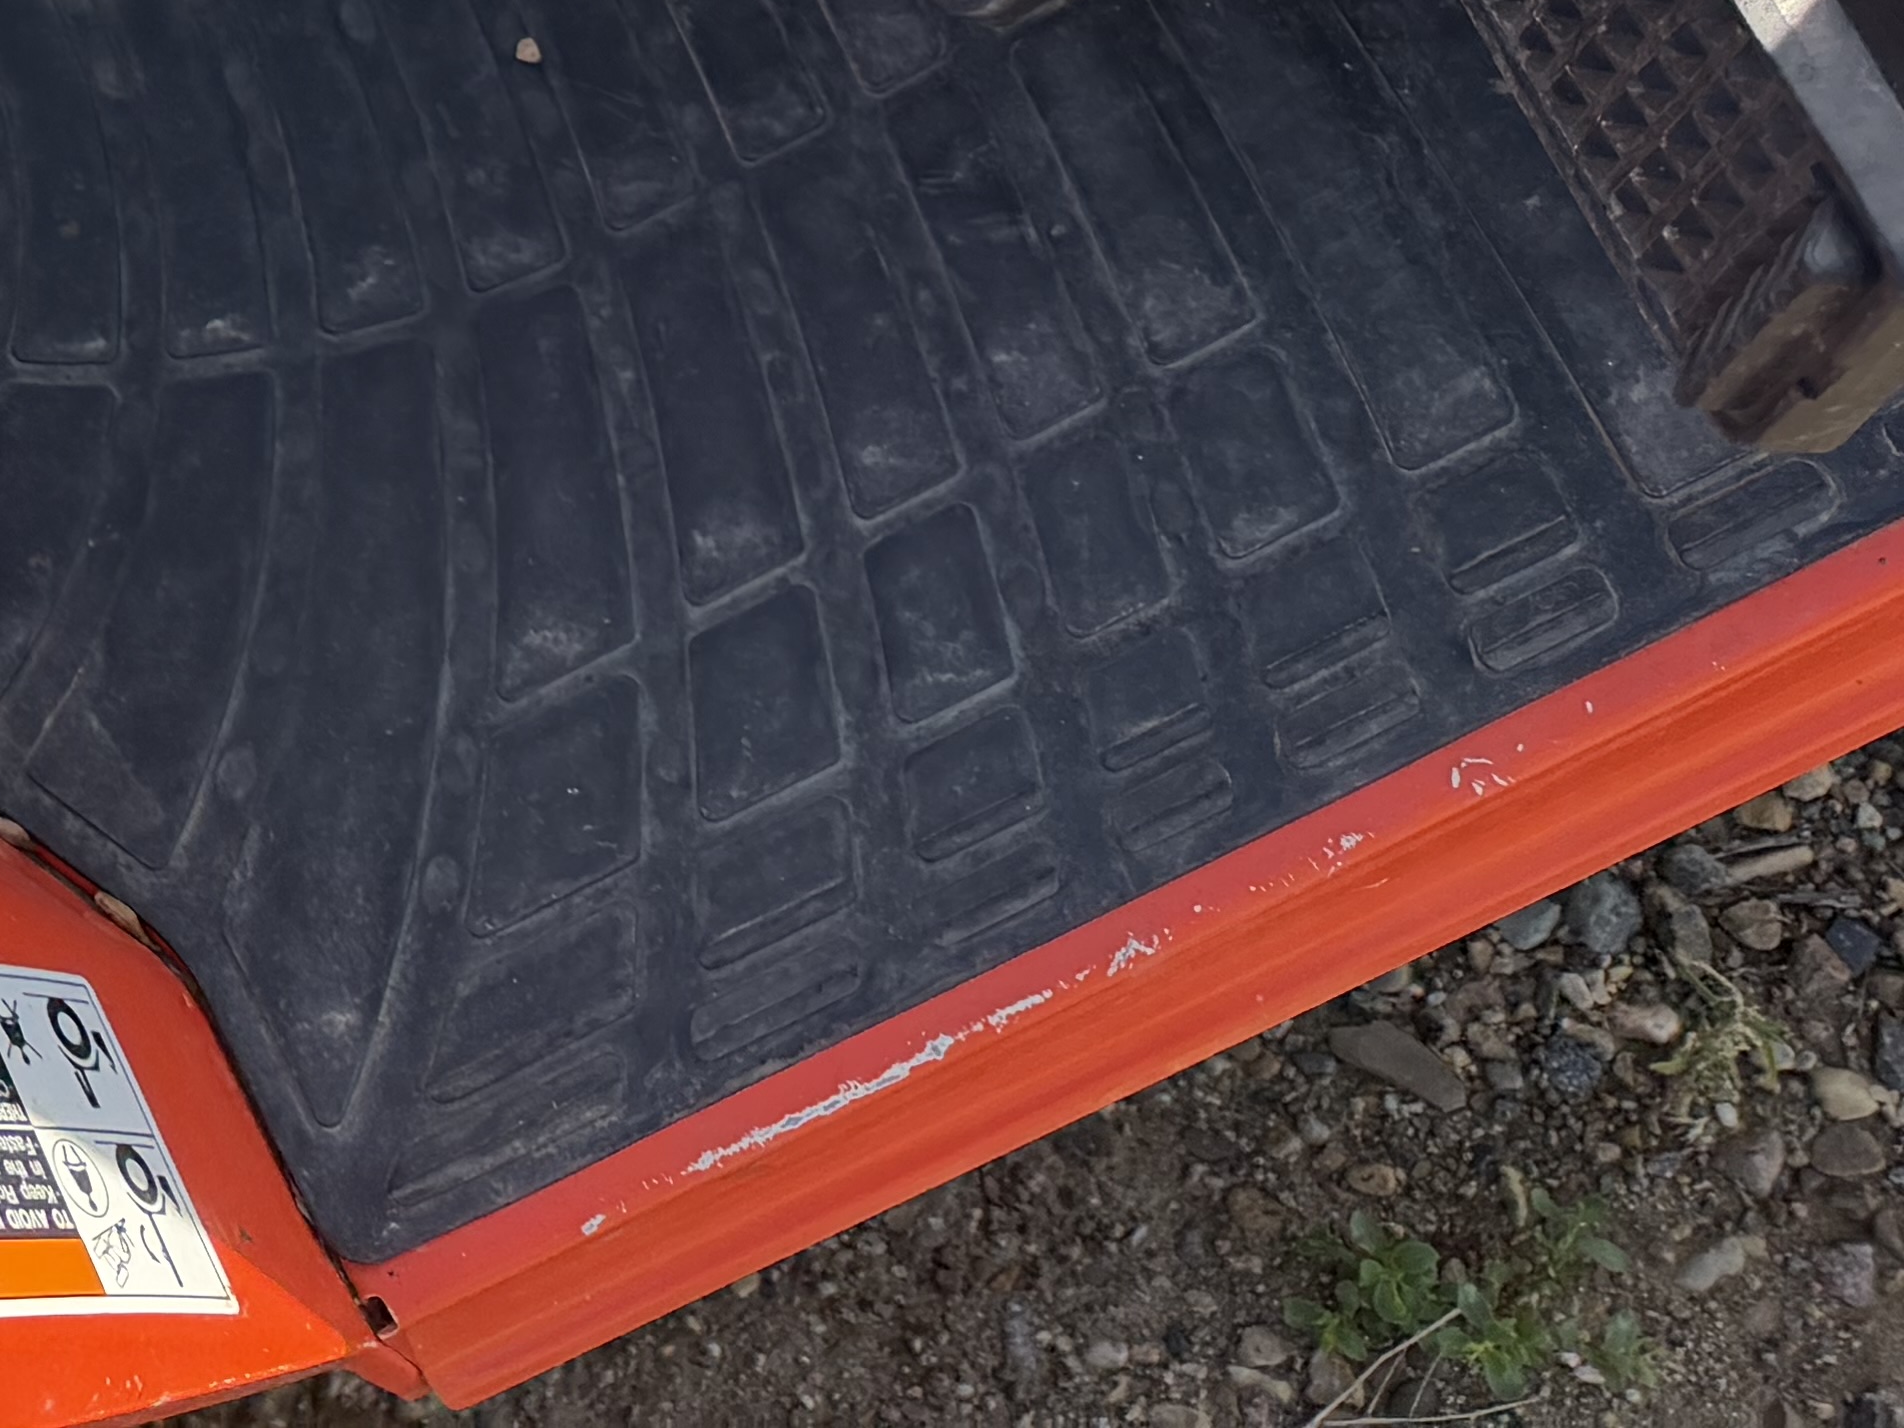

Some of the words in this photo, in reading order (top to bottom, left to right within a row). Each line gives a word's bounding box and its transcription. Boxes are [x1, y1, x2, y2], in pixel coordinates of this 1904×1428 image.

[5, 1161, 25, 1179] the
[32, 1161, 44, 1179] in
[6, 1209, 46, 1230] AVOID
[51, 1209, 71, 1228] TO
